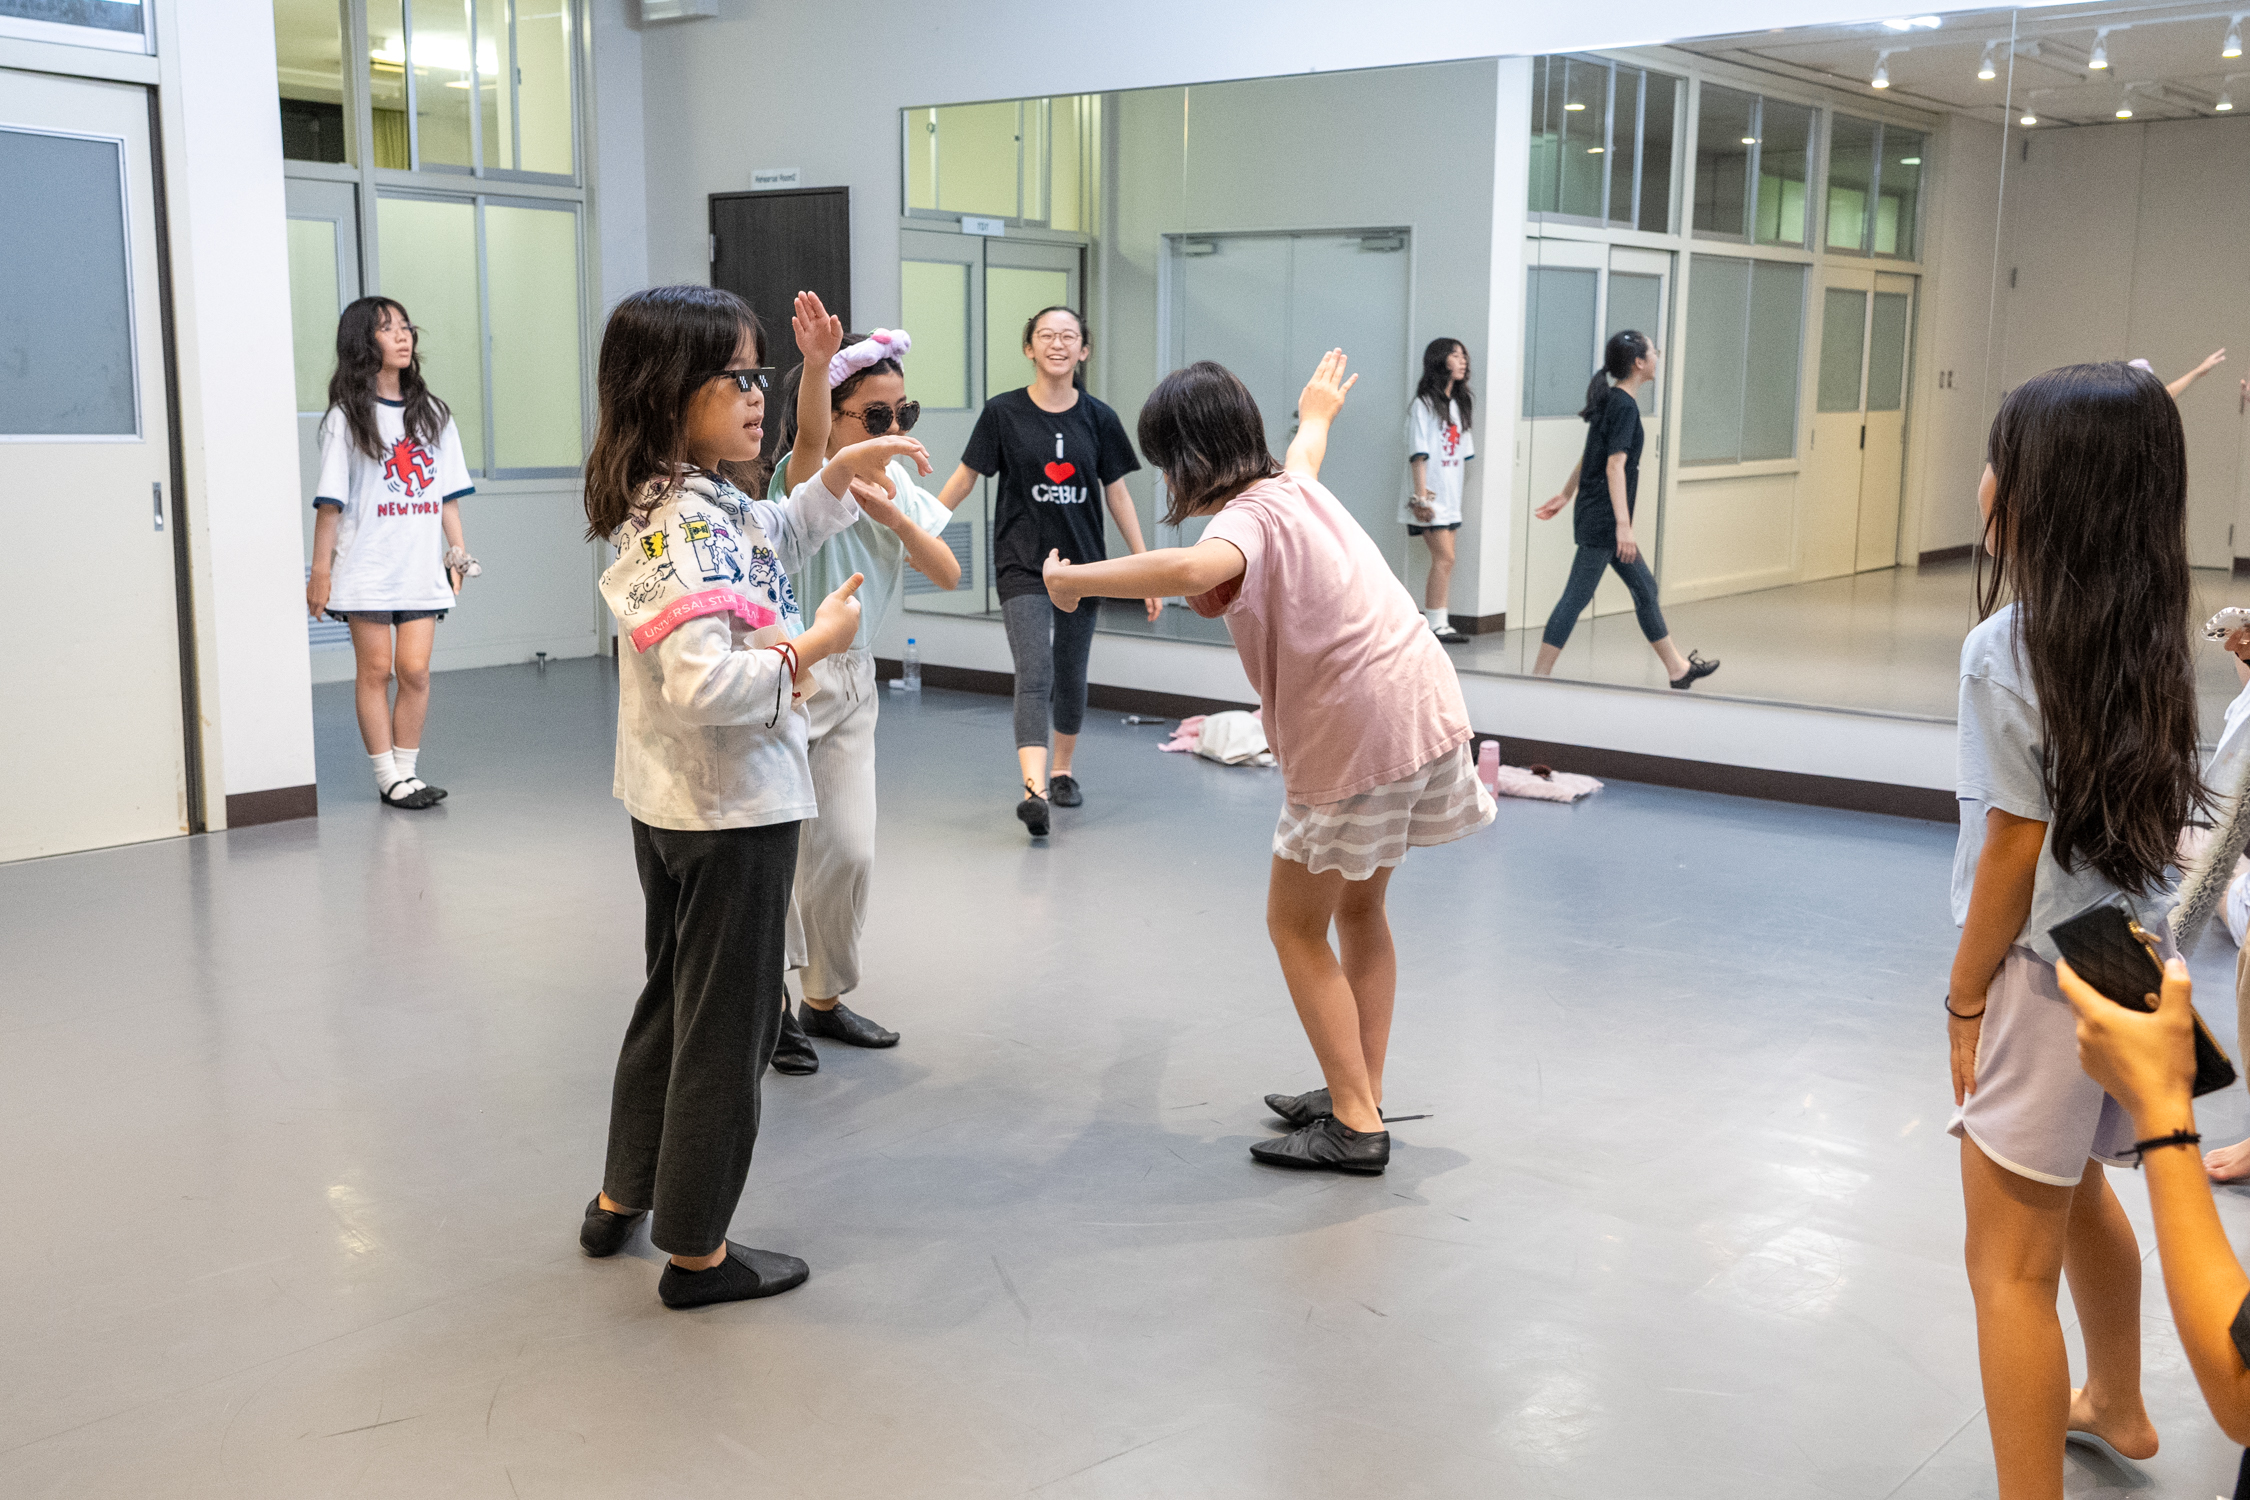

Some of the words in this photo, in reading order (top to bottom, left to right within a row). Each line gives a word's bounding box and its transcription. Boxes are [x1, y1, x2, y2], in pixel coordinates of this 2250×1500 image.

[1031, 483, 1088, 504] CEBU
[377, 501, 409, 517] NEW
[411, 501, 440, 515] YORK
[644, 600, 706, 637] UNIVERSAL
